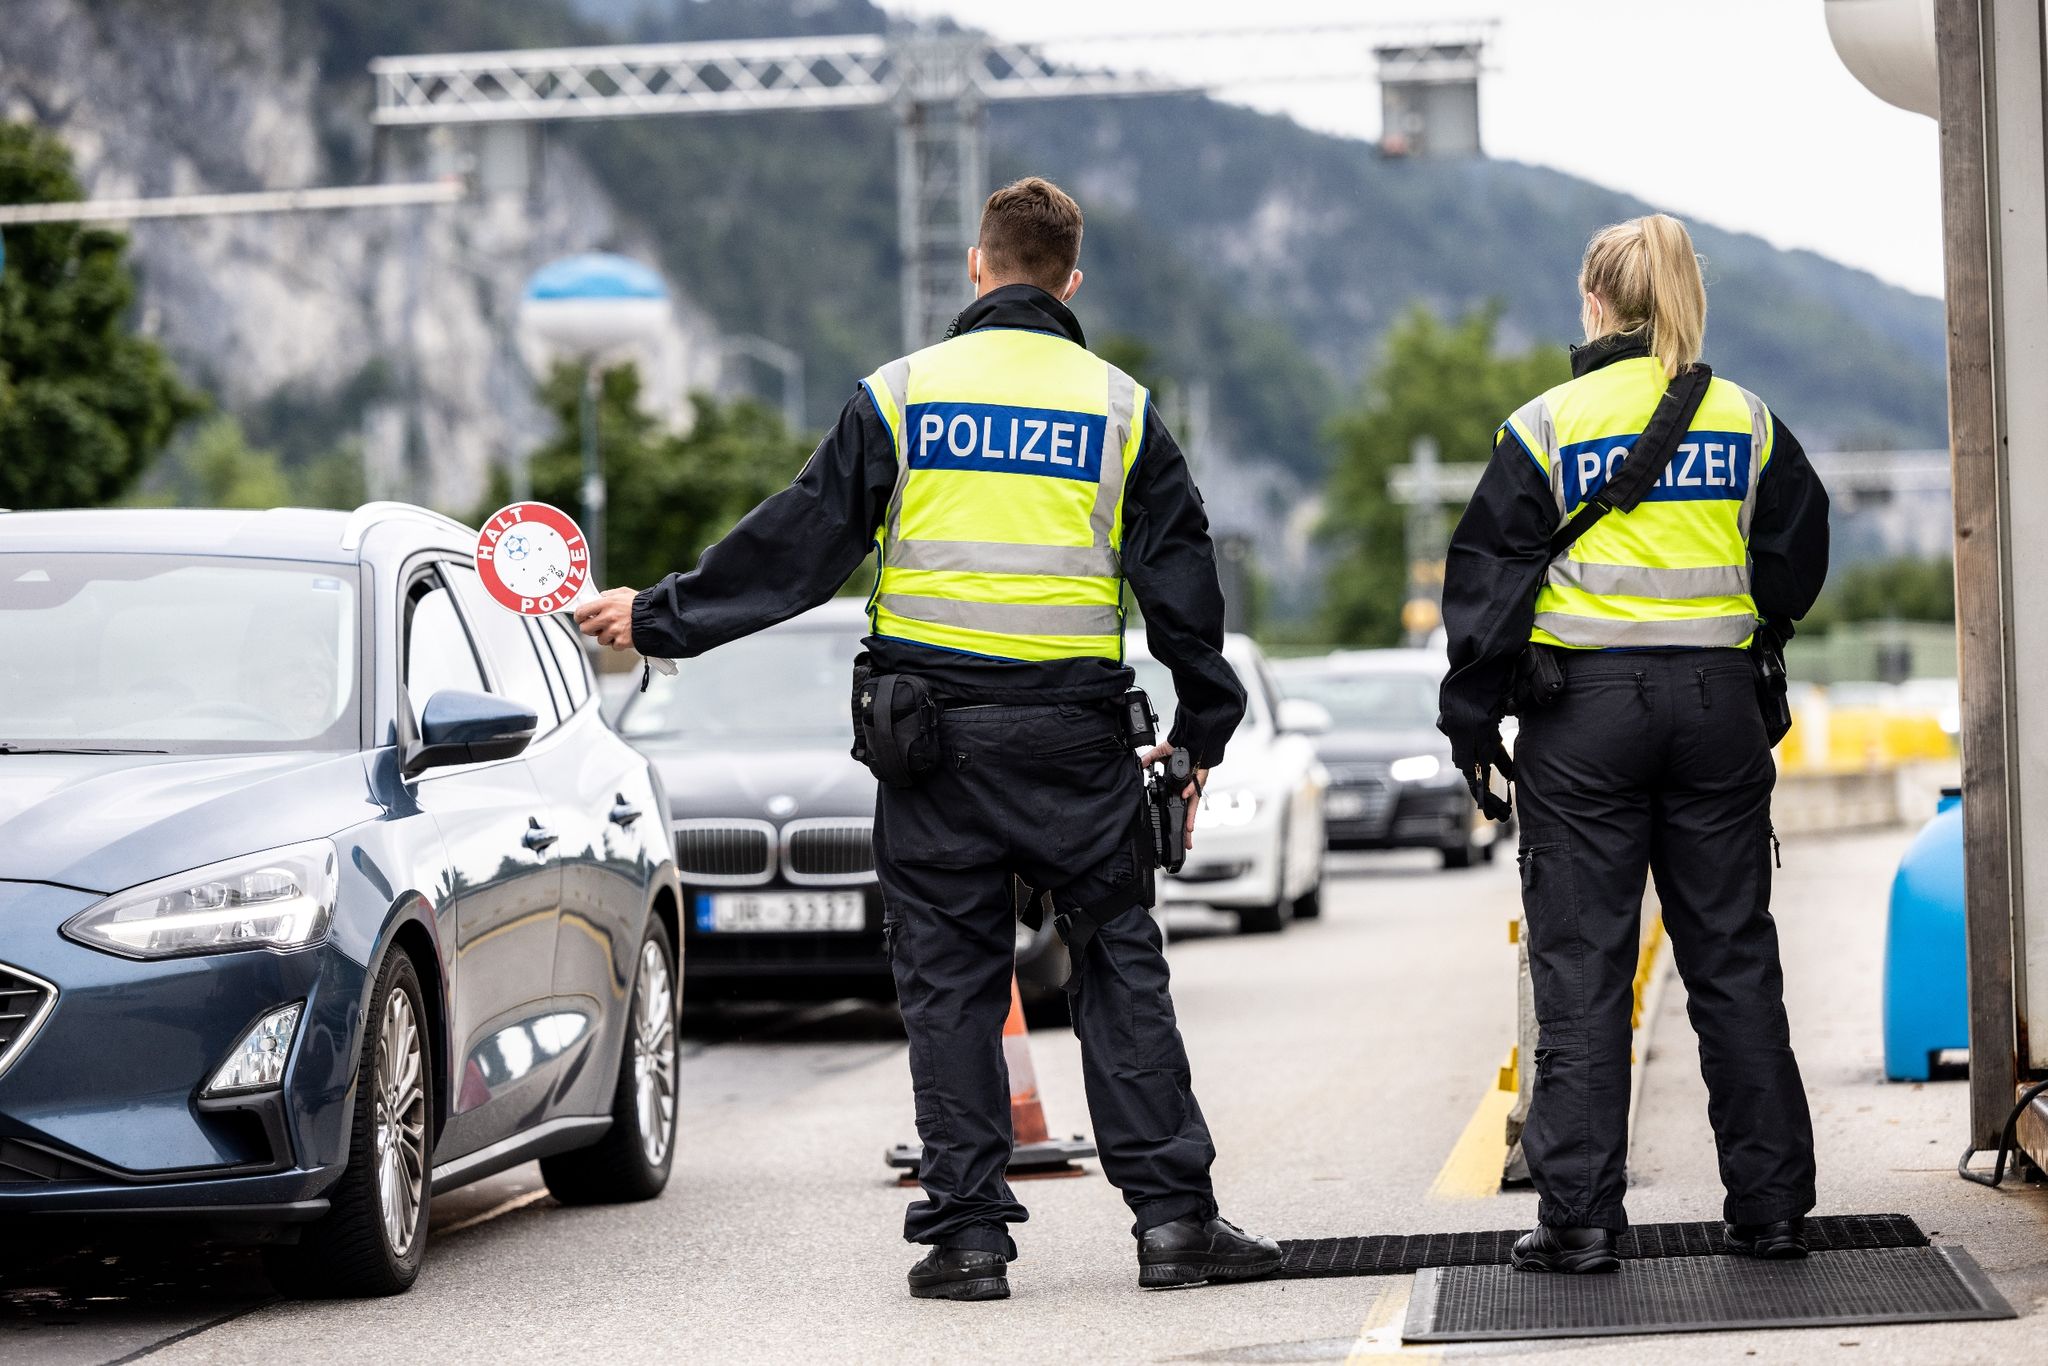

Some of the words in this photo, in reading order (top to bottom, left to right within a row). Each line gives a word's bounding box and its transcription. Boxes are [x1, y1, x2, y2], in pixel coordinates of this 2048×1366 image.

[919, 414, 1089, 468] POLIZEI
[1577, 443, 1737, 496] POIZEI
[478, 507, 523, 561] HALT
[520, 535, 586, 613] POLIZEI
